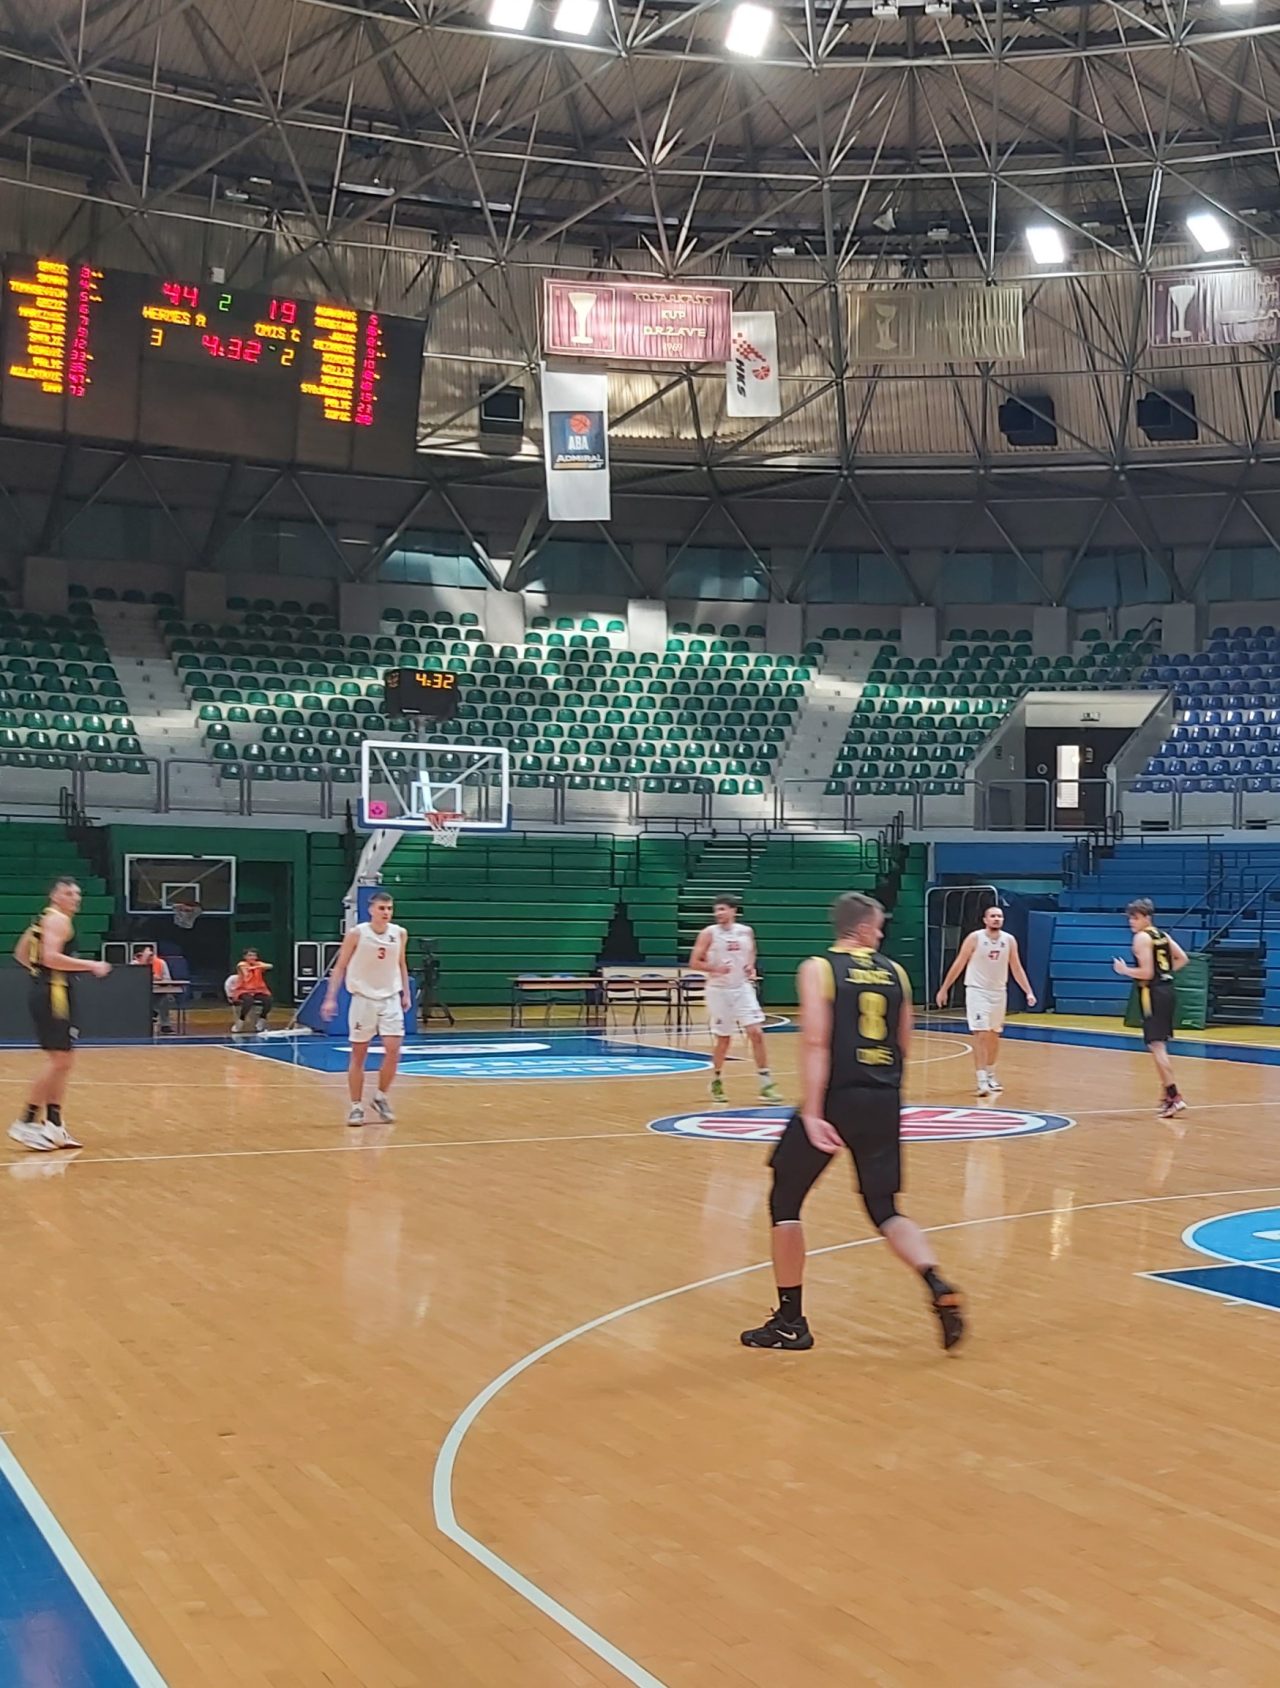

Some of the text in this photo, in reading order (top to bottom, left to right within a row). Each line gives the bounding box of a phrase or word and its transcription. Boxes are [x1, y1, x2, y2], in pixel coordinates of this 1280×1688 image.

[163, 282, 199, 307] 44
[219, 294, 232, 311] 2
[269, 299, 297, 324] 19
[662, 309, 686, 320] KUP
[150, 328, 163, 346] 3
[202, 335, 263, 363] 4:32
[281, 349, 295, 366] 2
[735, 359, 747, 399] HKS
[568, 435, 589, 451] ABA
[556, 453, 604, 464] ADMIRAL
[415, 673, 455, 689] 4:32
[377, 947, 386, 960] 3
[1157, 949, 1169, 971] 5
